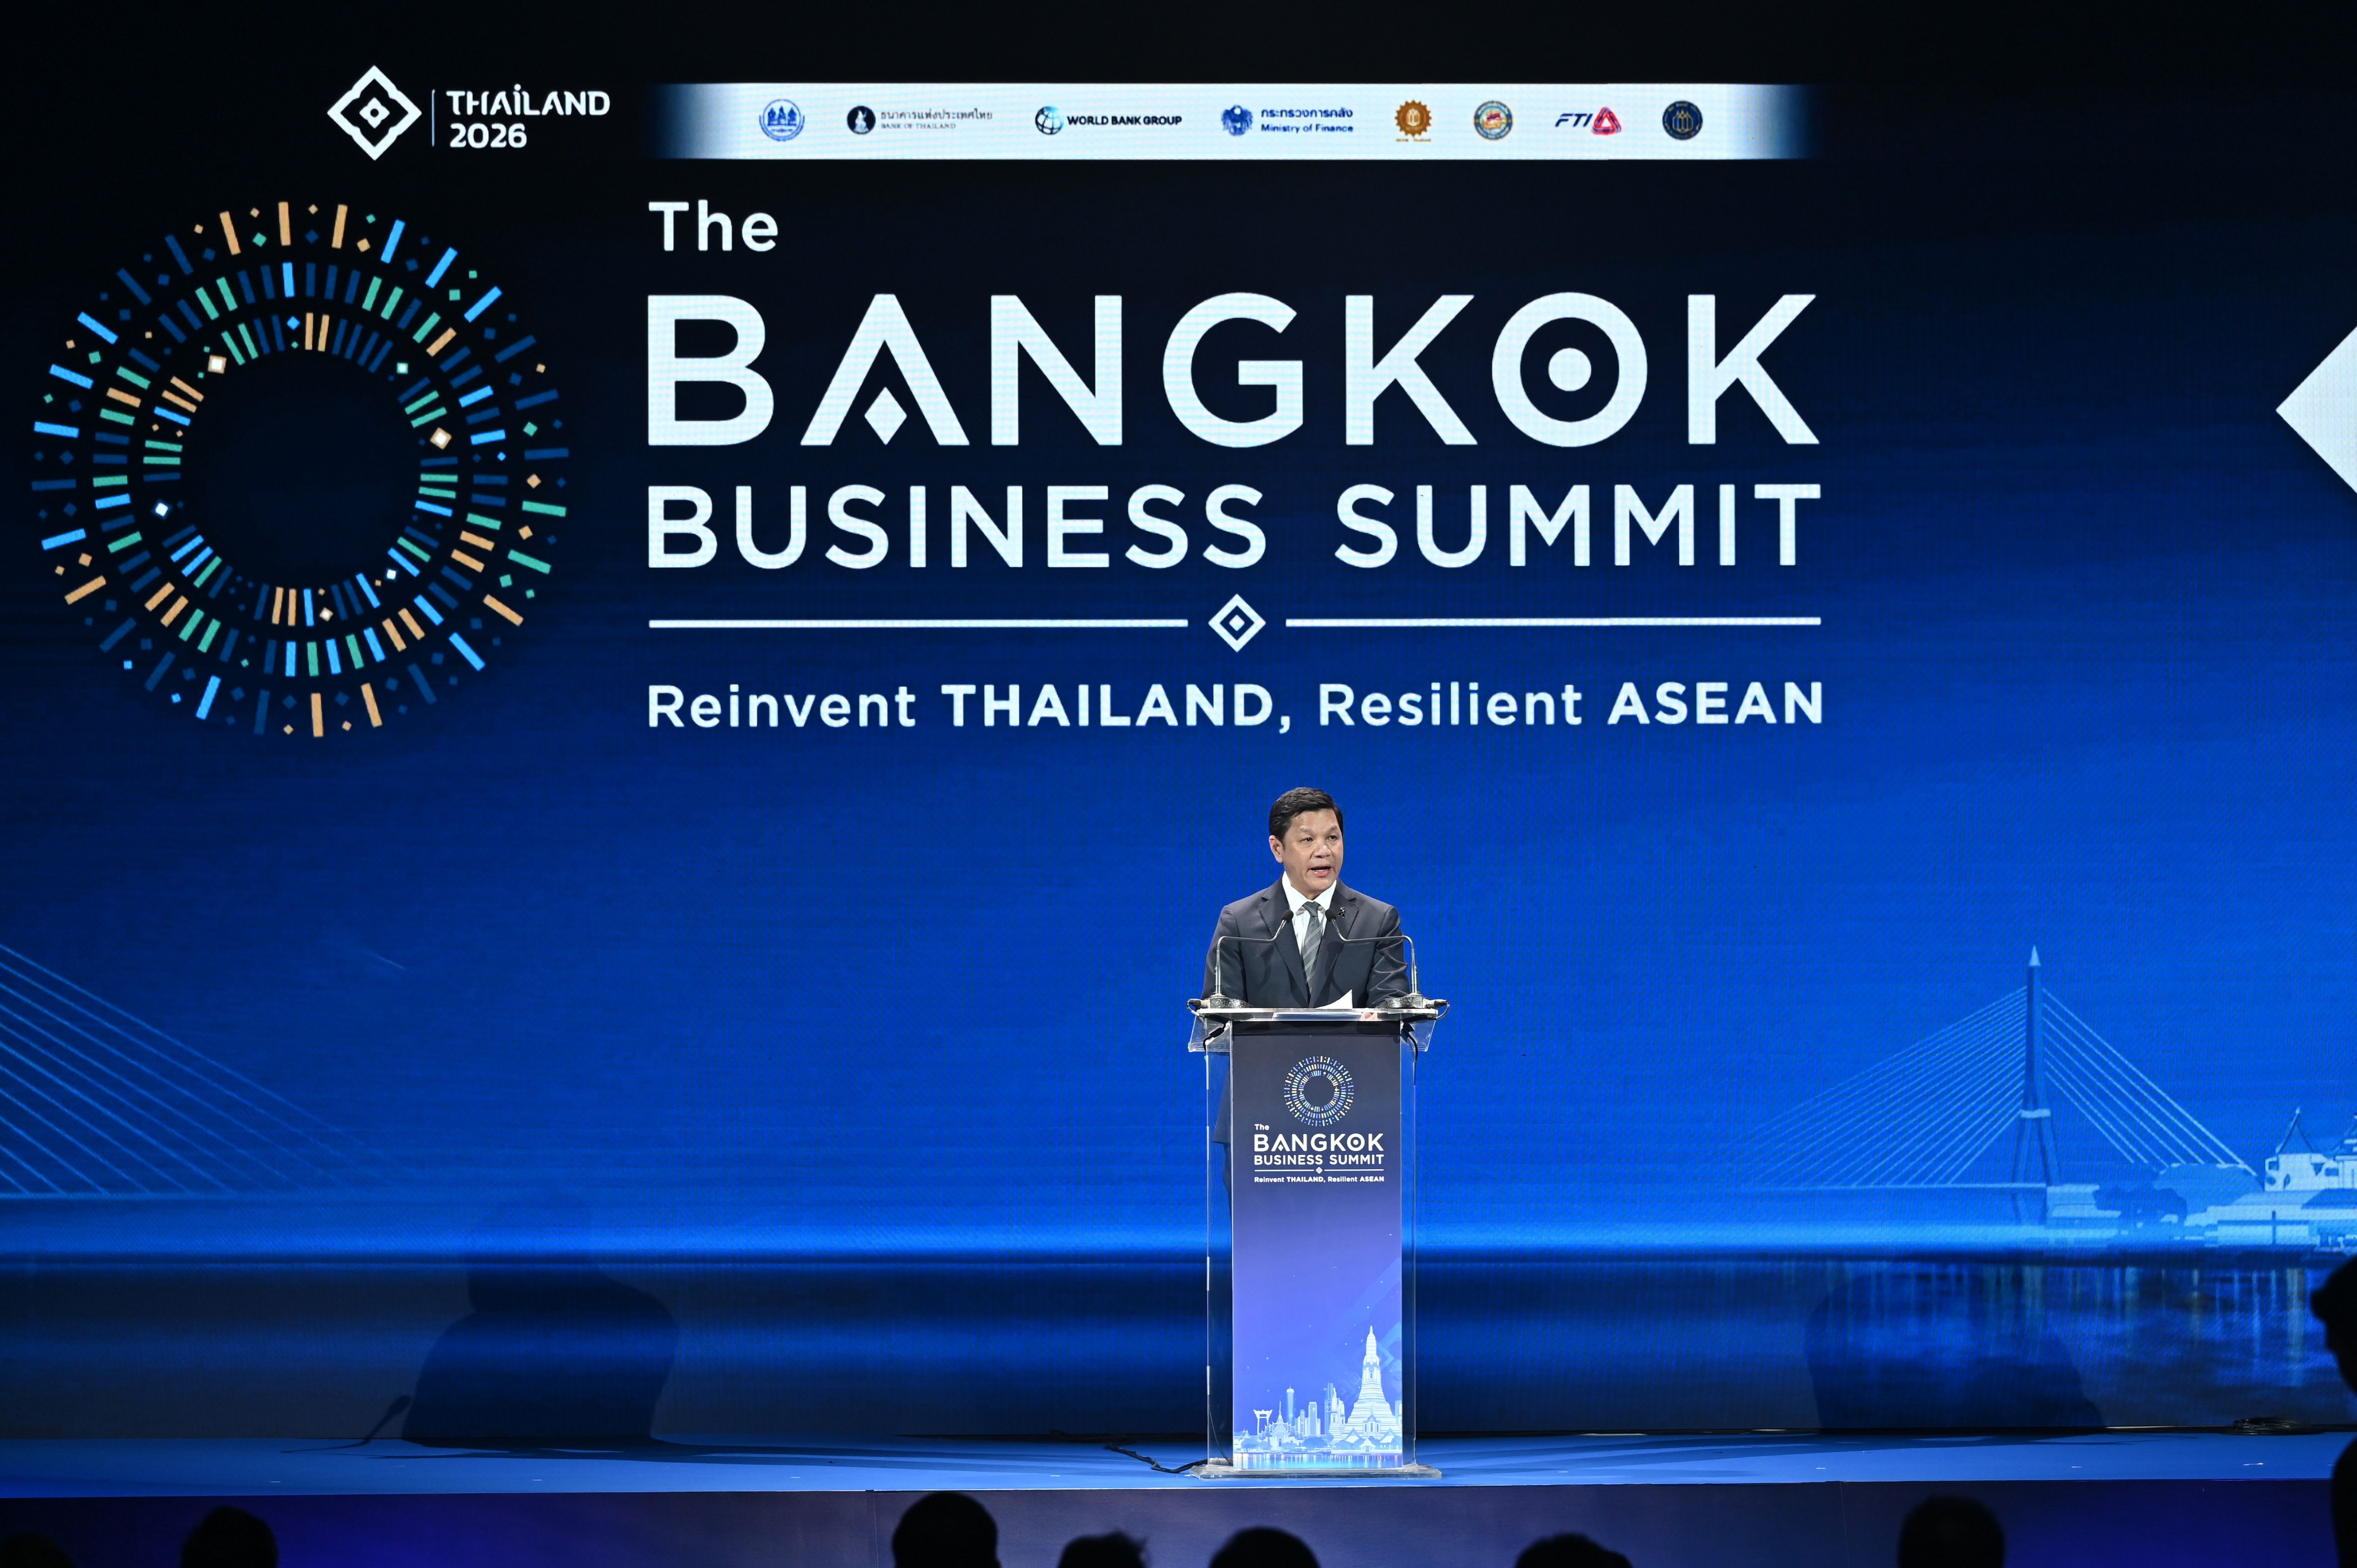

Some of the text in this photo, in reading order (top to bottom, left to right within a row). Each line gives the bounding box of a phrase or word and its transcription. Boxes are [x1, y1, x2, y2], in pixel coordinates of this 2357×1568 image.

[1067, 115, 1182, 125] WORLD BANK GROUP
[1261, 107, 1353, 118] กระทรวงการคลัง
[1555, 113, 1593, 127] FTI
[450, 123, 528, 149] 2026
[1261, 124, 1354, 133] Ministry of Finance
[648, 200, 778, 252] The
[648, 292, 1819, 448] BANGKOK
[648, 484, 1821, 569] BUSINESS SUMMIT
[649, 681, 1822, 733] Reinvent THAILAND, Resilient ASEAN
[1254, 1133, 1384, 1152] BANGKOK
[1254, 1154, 1384, 1165] BUSINESS SUMMIT
